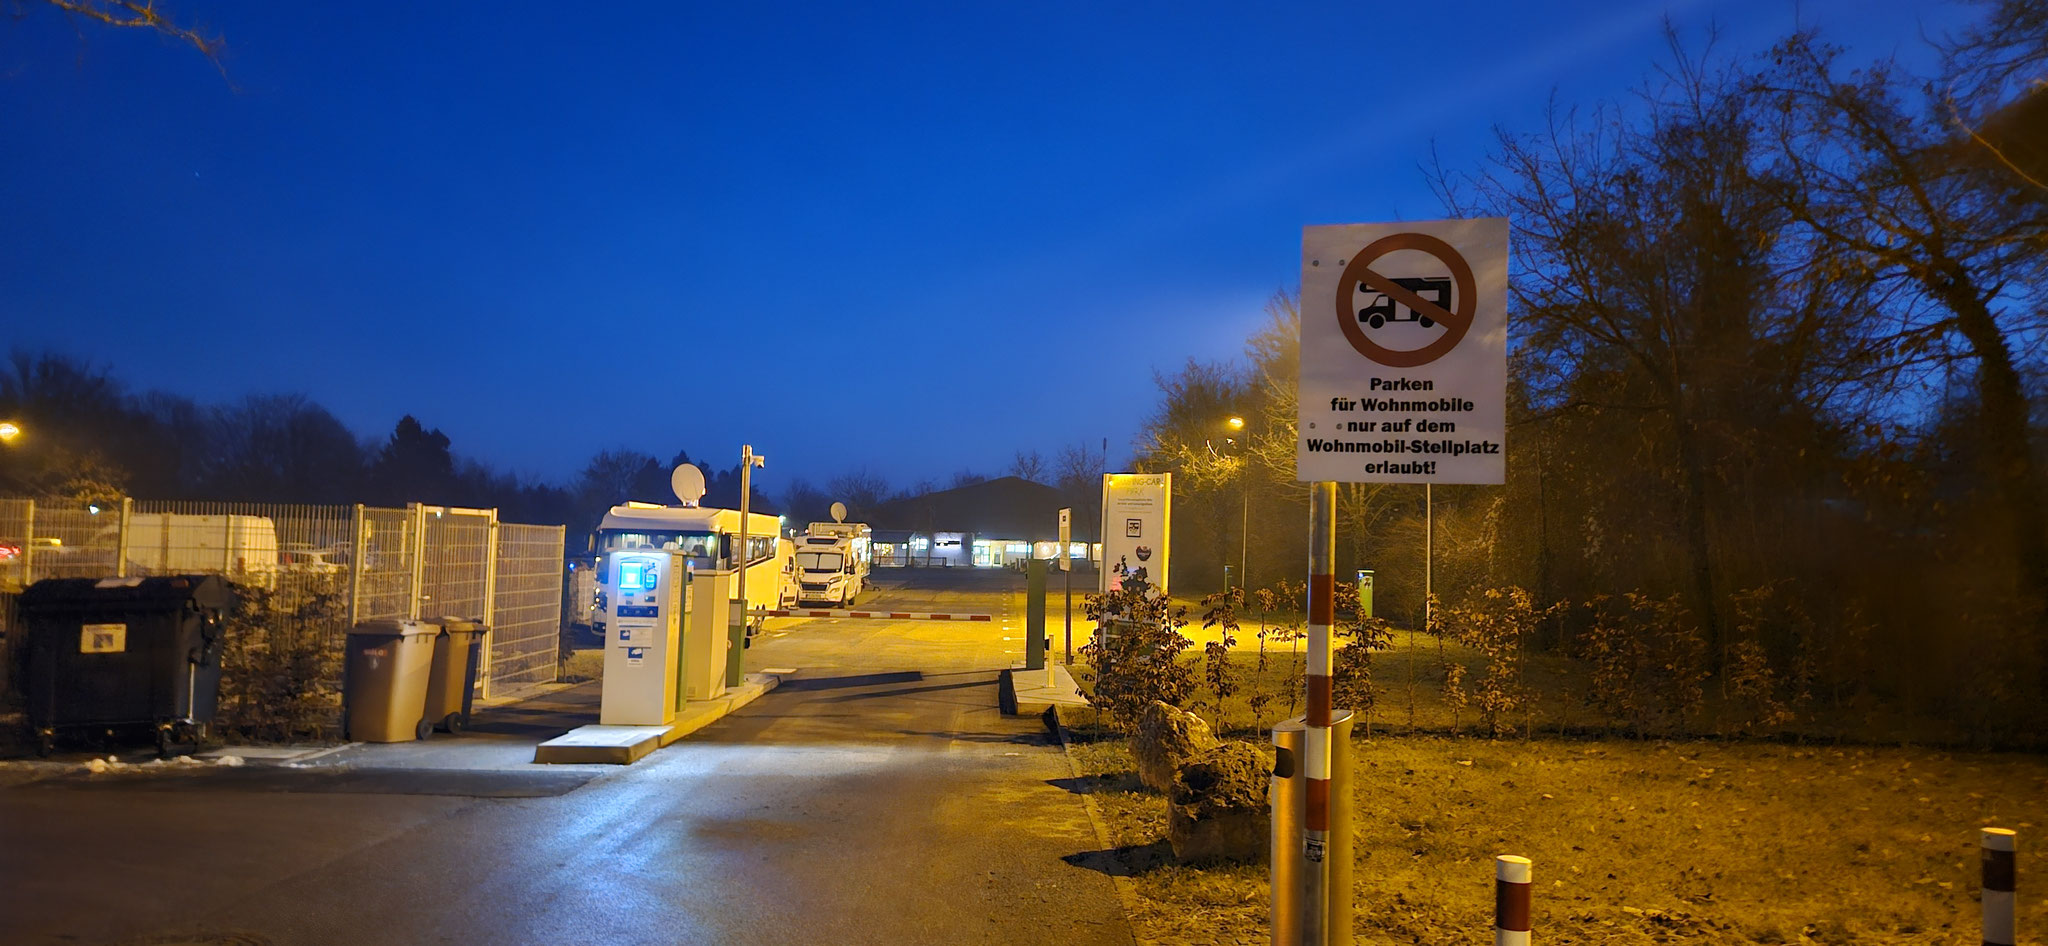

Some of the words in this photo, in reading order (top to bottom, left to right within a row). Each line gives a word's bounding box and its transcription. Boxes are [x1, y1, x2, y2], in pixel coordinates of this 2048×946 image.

[1370, 377, 1434, 391] Parken
[1330, 397, 1357, 412] für
[1361, 397, 1474, 412] Wohnmobile
[1347, 421, 1377, 433] nur
[1381, 418, 1412, 433] auf
[1416, 418, 1456, 433] dem
[1306, 438, 1500, 457] Wohnmobil-Stellplatz
[1364, 460, 1437, 475] erlaubt!
